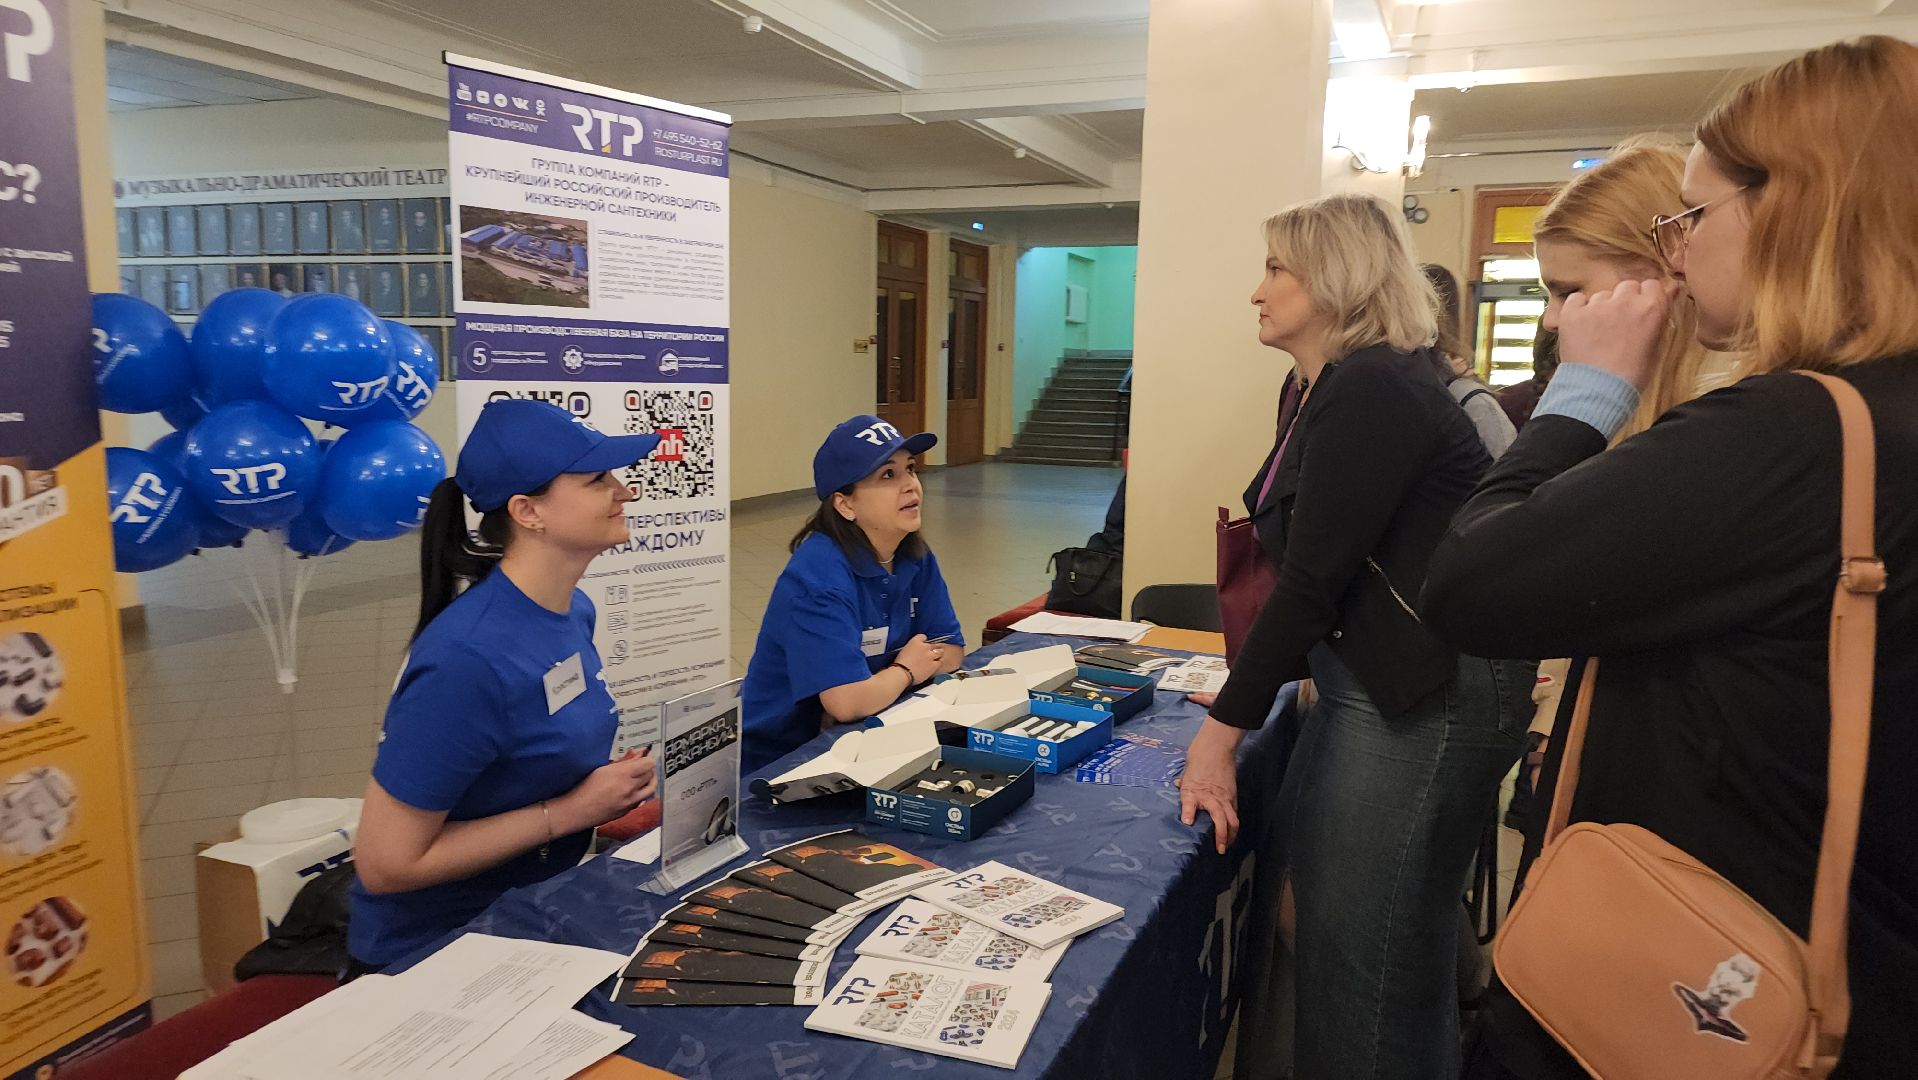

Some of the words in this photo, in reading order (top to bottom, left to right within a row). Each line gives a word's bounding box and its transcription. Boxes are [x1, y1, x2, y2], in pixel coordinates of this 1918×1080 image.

[465, 112, 538, 133] #RTPCOMPANY
[560, 102, 644, 157] RTP
[393, 168, 448, 186] ТЕАТР
[531, 157, 576, 175] ГРУППА
[578, 164, 641, 186] КОМПАНИЙ
[642, 175, 663, 187] RTP
[464, 164, 551, 190] КРУПНЕЙШИЙ
[553, 178, 633, 200] РОССИЙСКИЙ
[634, 190, 722, 213] ПРОИЗВОДИТЕЛЬ
[525, 191, 606, 212] ИНЖЕНЕРНОЙ
[607, 203, 678, 223] САНТЕХНИКИ
[465, 321, 512, 333] МОЩНАЯ
[472, 347, 487, 366] 5
[331, 376, 389, 404] RTP
[396, 360, 433, 409] RTP
[853, 422, 901, 446] RTP
[210, 463, 287, 495] RTP
[111, 472, 168, 524] RTP
[625, 507, 727, 529] ПЕРСПЕКТИВЫ
[971, 731, 995, 746] RTP
[871, 791, 898, 809] RTP
[943, 873, 986, 889] RTP
[880, 914, 920, 937] RTP
[832, 977, 876, 1006] RTP
